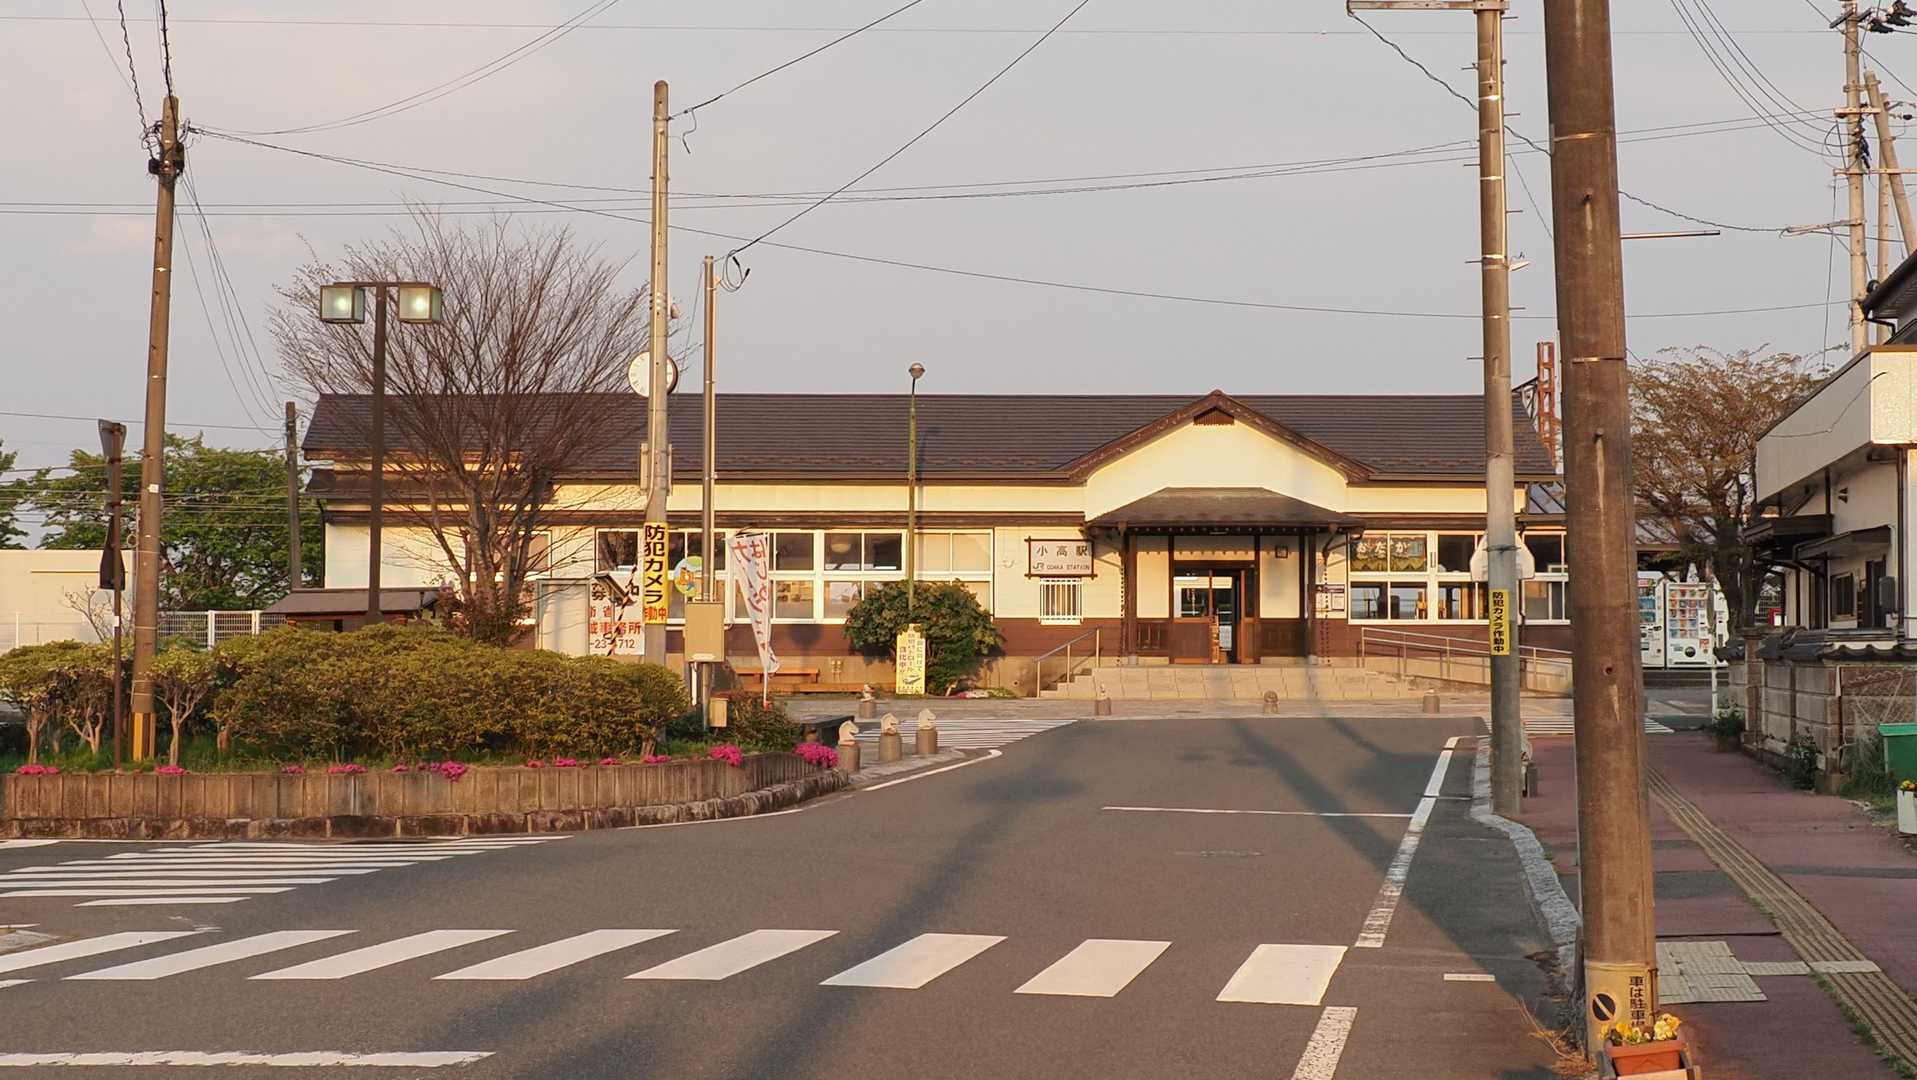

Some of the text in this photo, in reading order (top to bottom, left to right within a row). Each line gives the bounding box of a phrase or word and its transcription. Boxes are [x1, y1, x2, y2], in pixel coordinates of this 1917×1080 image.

[1036, 545, 1088, 557] 小高駅
[644, 524, 666, 605] 防犯カメラ
[590, 639, 635, 648] -23-712
